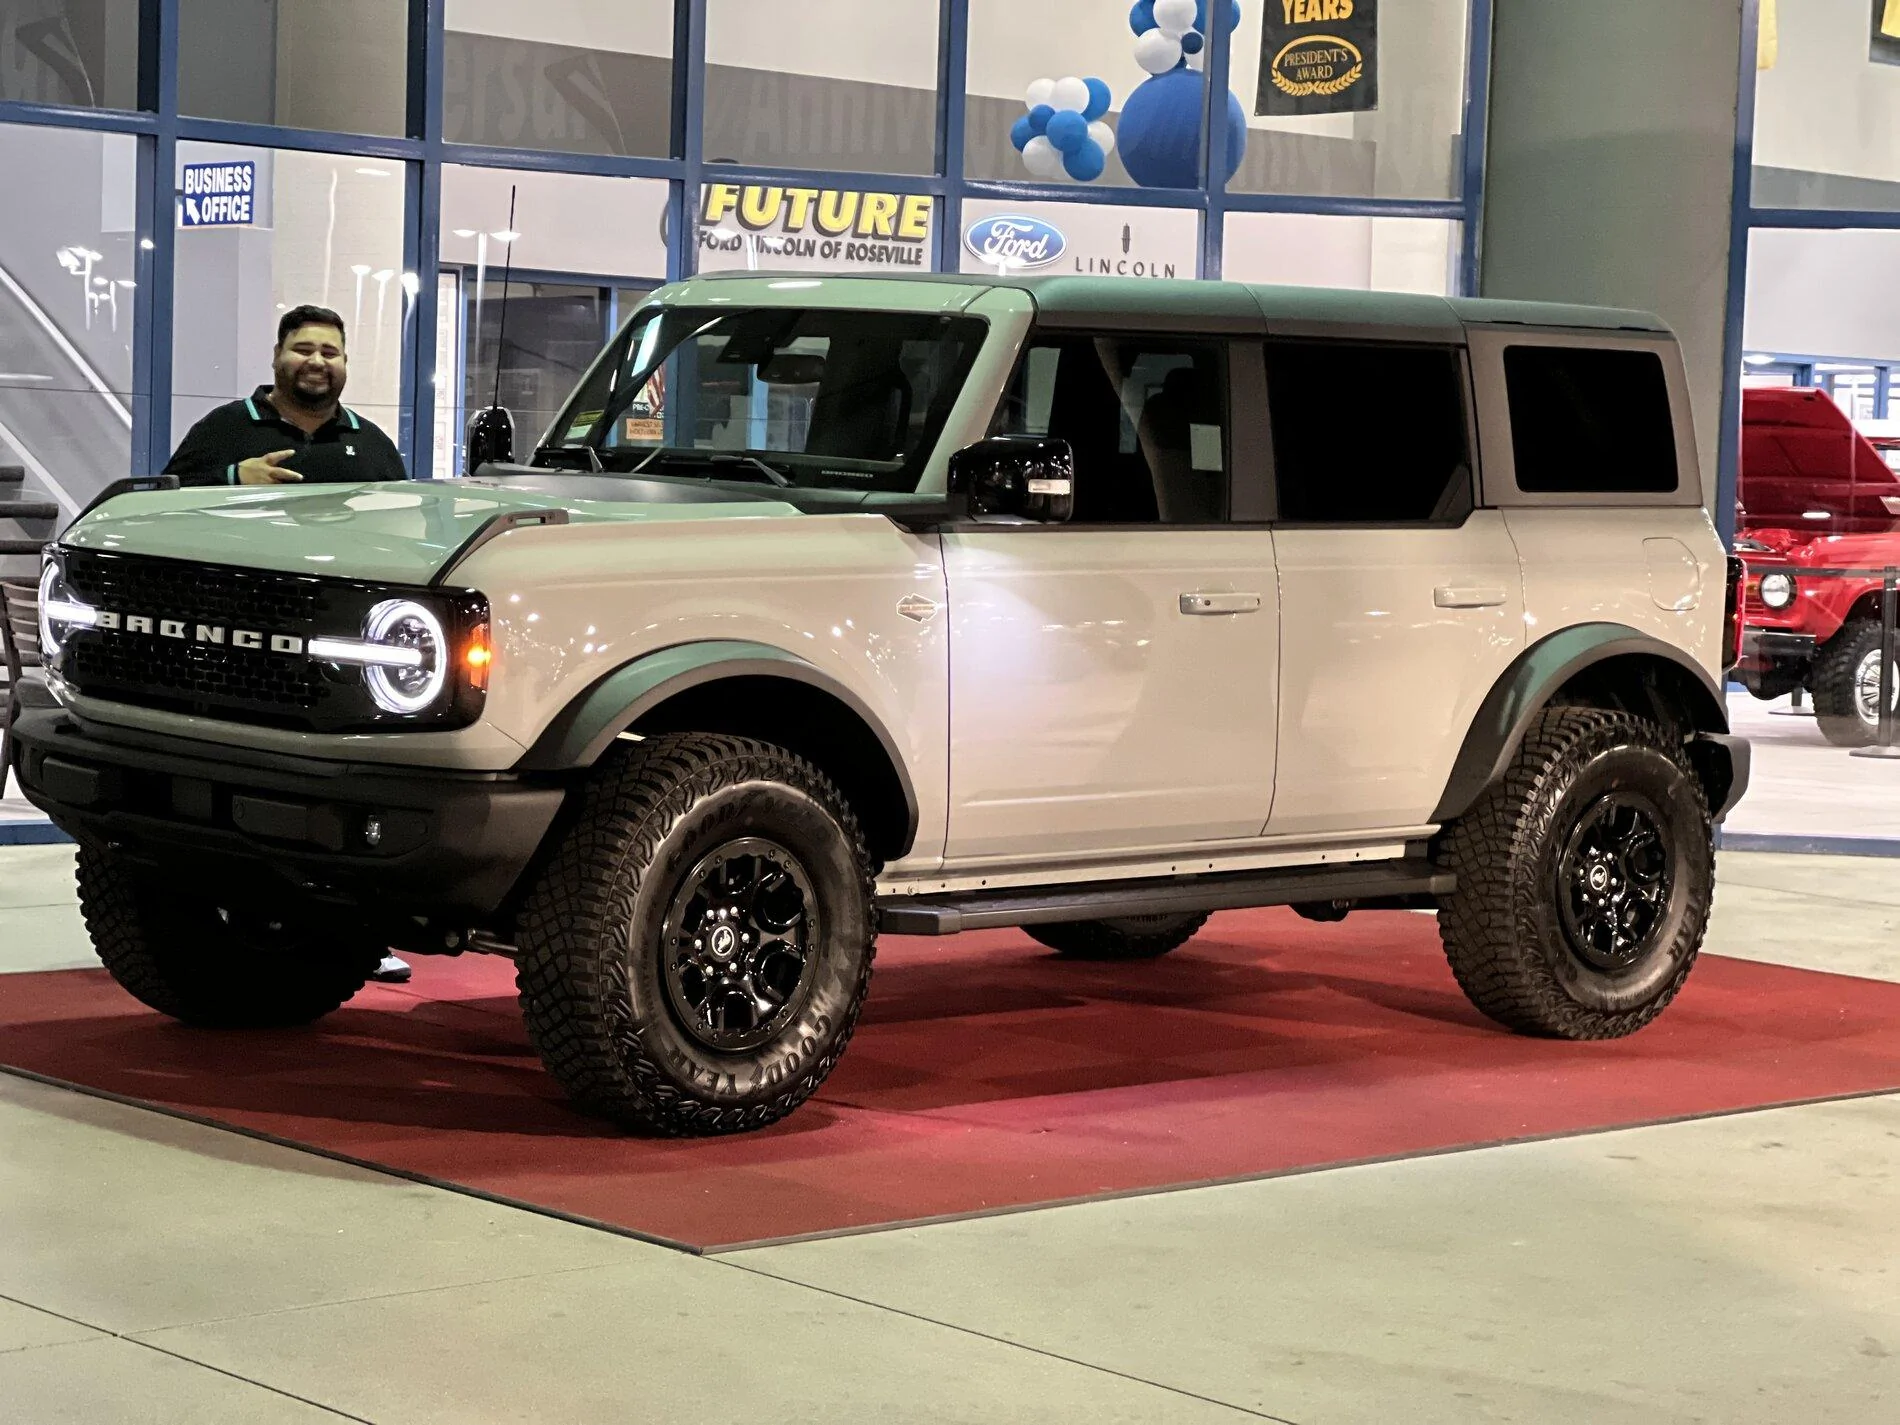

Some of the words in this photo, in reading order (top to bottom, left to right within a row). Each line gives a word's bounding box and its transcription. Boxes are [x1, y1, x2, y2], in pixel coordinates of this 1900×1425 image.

[1282, 0, 1354, 25] YEARS
[1284, 48, 1348, 67] PRESIDENT'S
[1296, 65, 1333, 81] AWARD
[184, 165, 252, 195] BUSINESS
[201, 195, 251, 222] OFFICE
[701, 184, 934, 242] FUTURE
[749, 234, 816, 257] INCOLN
[820, 241, 843, 259] OF
[846, 241, 922, 265] ROSEVILLE
[984, 220, 1049, 260] Ford
[1075, 256, 1176, 279] LINCOLN
[95, 610, 303, 654] BRONCO
